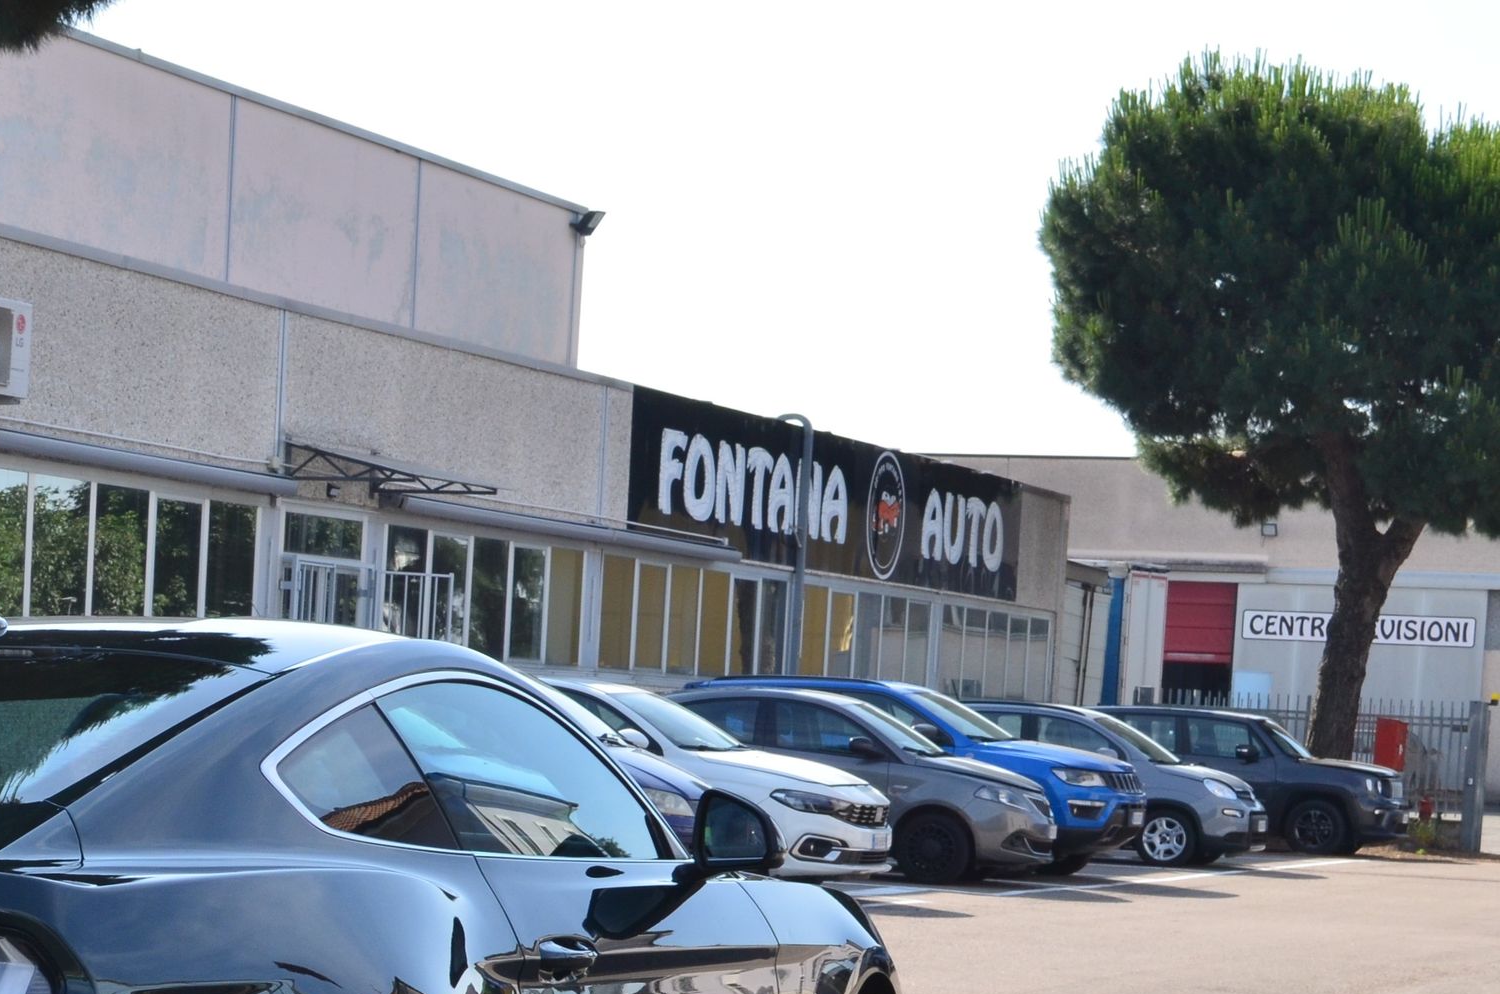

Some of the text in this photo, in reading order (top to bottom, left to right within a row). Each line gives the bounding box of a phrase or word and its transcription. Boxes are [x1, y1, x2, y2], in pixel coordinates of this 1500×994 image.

[657, 428, 848, 545] FONTANA
[920, 488, 1004, 573] AUTO
[1250, 614, 1469, 643] CENTR VISIONI
